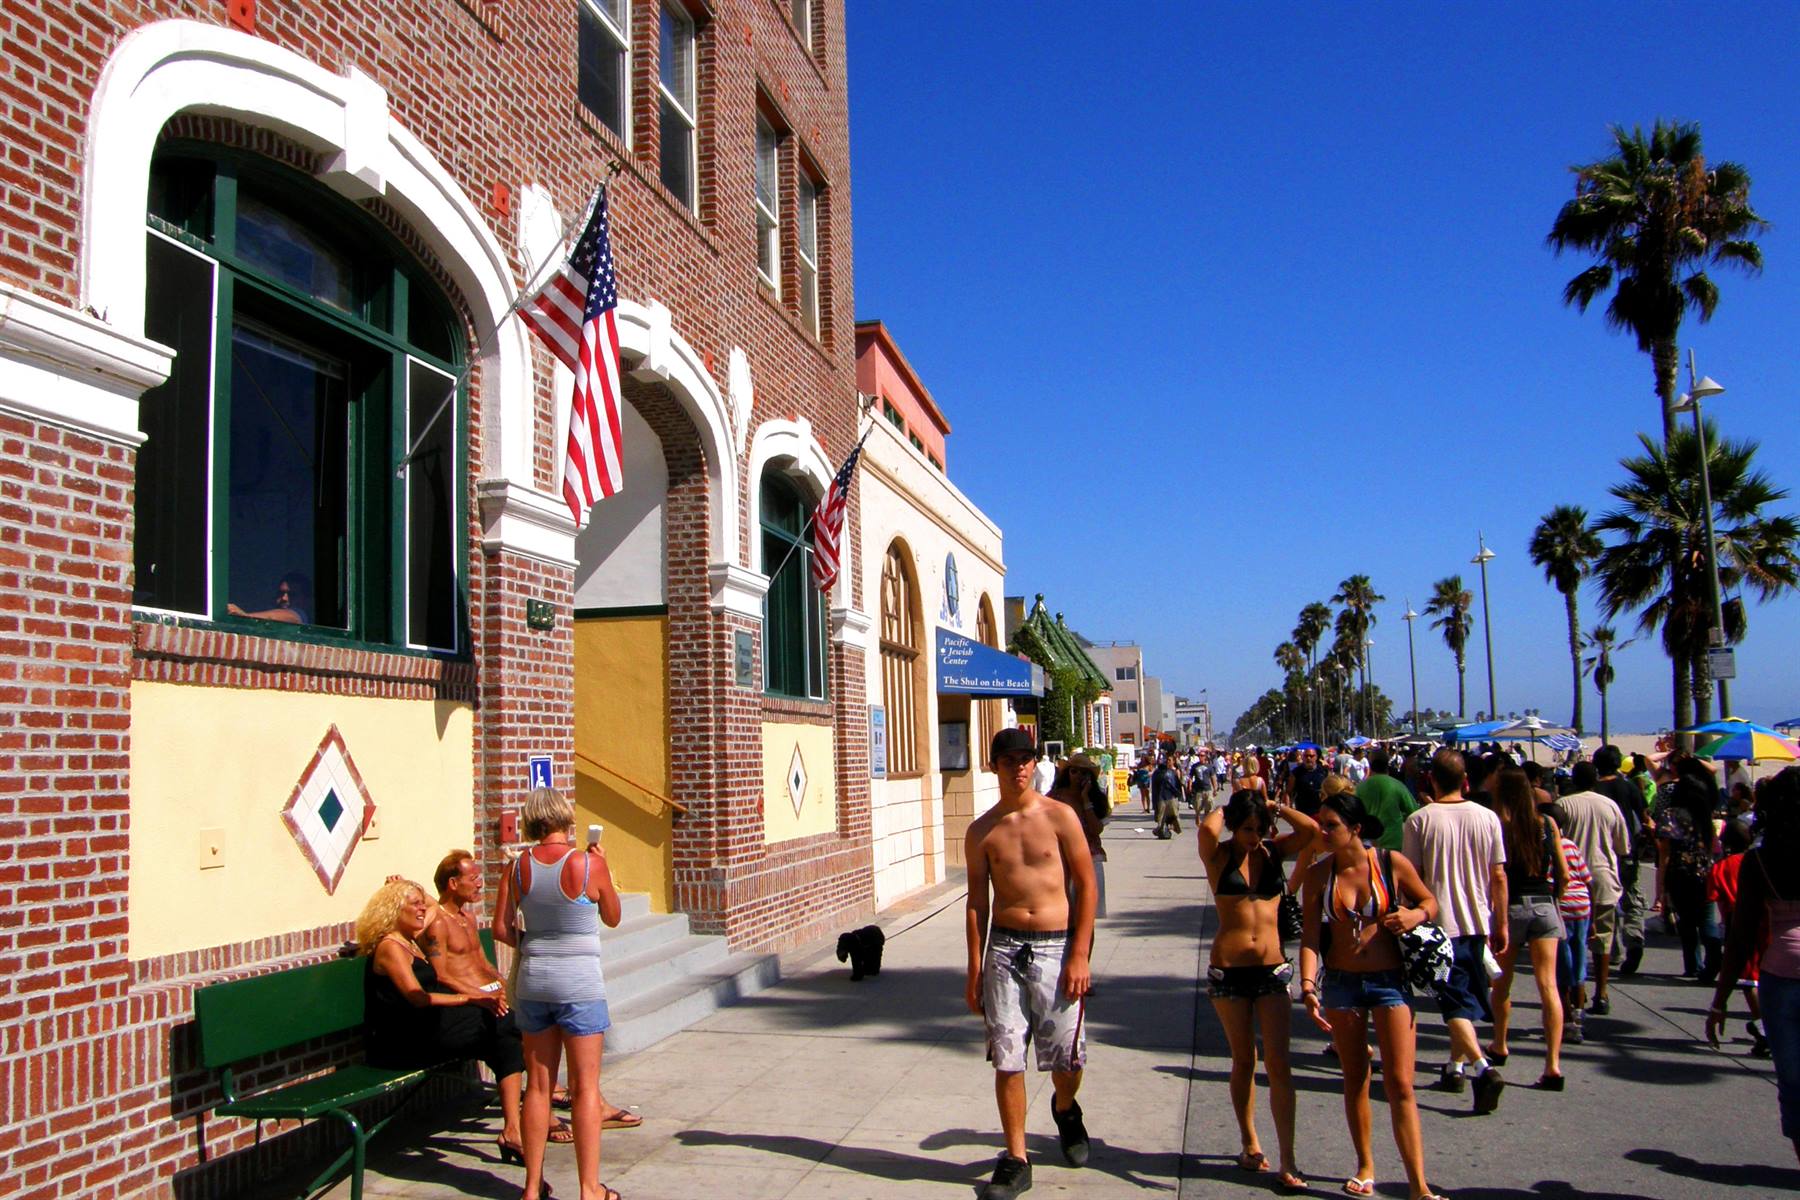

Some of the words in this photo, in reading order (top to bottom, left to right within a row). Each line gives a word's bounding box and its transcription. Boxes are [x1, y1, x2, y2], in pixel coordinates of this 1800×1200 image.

[944, 637, 969, 647] Pacific
[948, 648, 974, 656] Jewish
[943, 657, 969, 665] Center
[943, 676, 959, 685] The
[960, 677, 978, 686] Shul
[992, 679, 1005, 687] the
[1006, 680, 1030, 688] Beach
